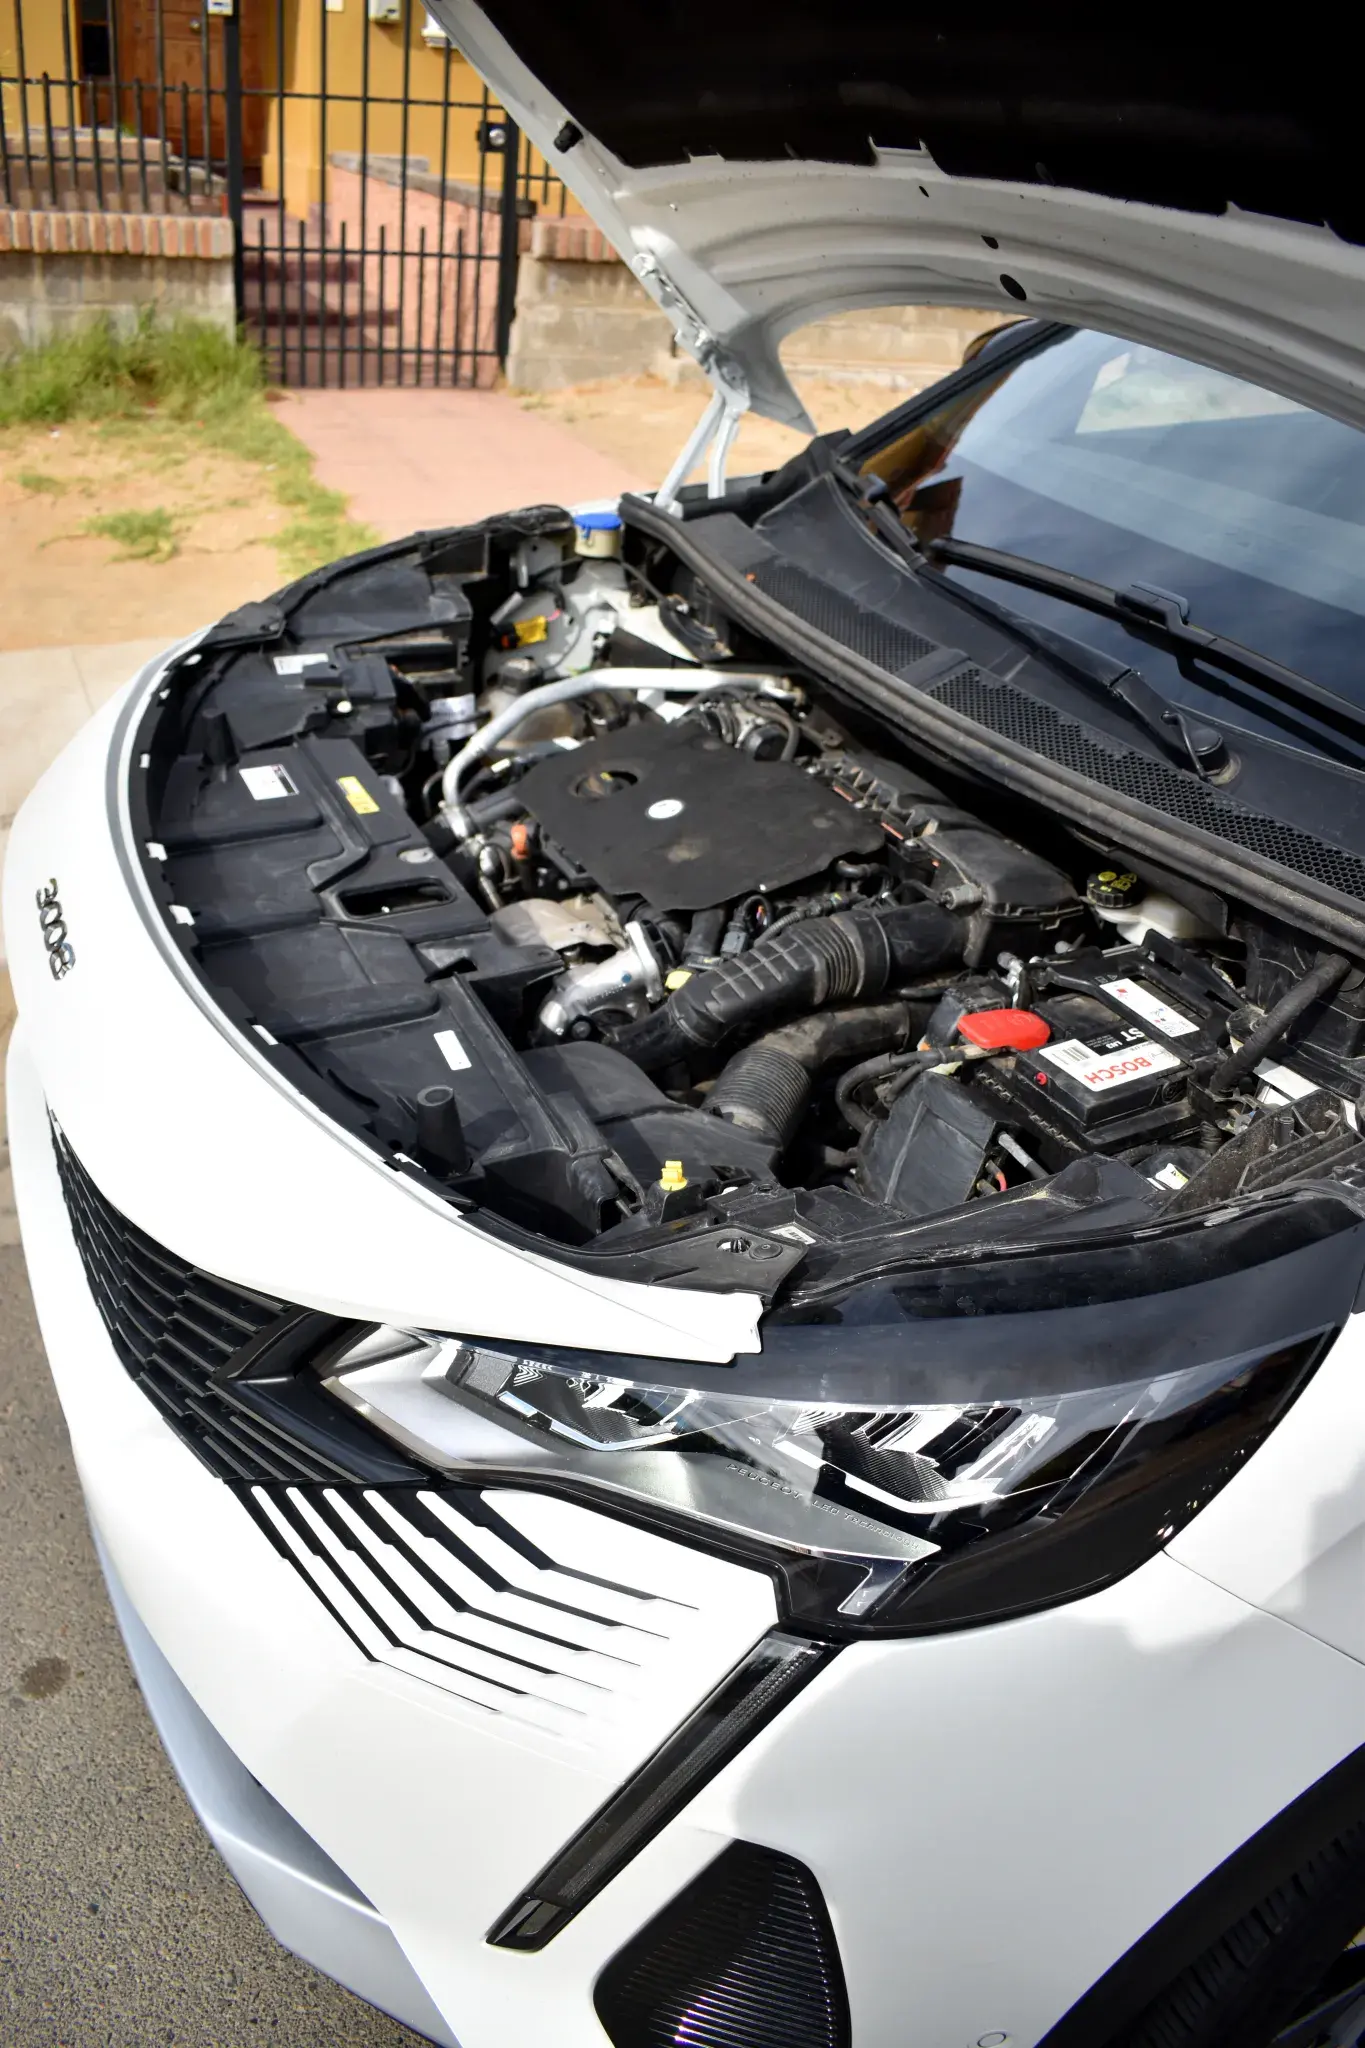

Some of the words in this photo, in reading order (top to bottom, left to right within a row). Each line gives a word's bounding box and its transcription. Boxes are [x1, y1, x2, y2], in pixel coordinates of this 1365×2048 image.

[36, 878, 76, 981] 3008
[1084, 1056, 1152, 1084] BOSCH
[724, 1462, 803, 1500] PEUGEOT
[811, 1500, 840, 1516] LED
